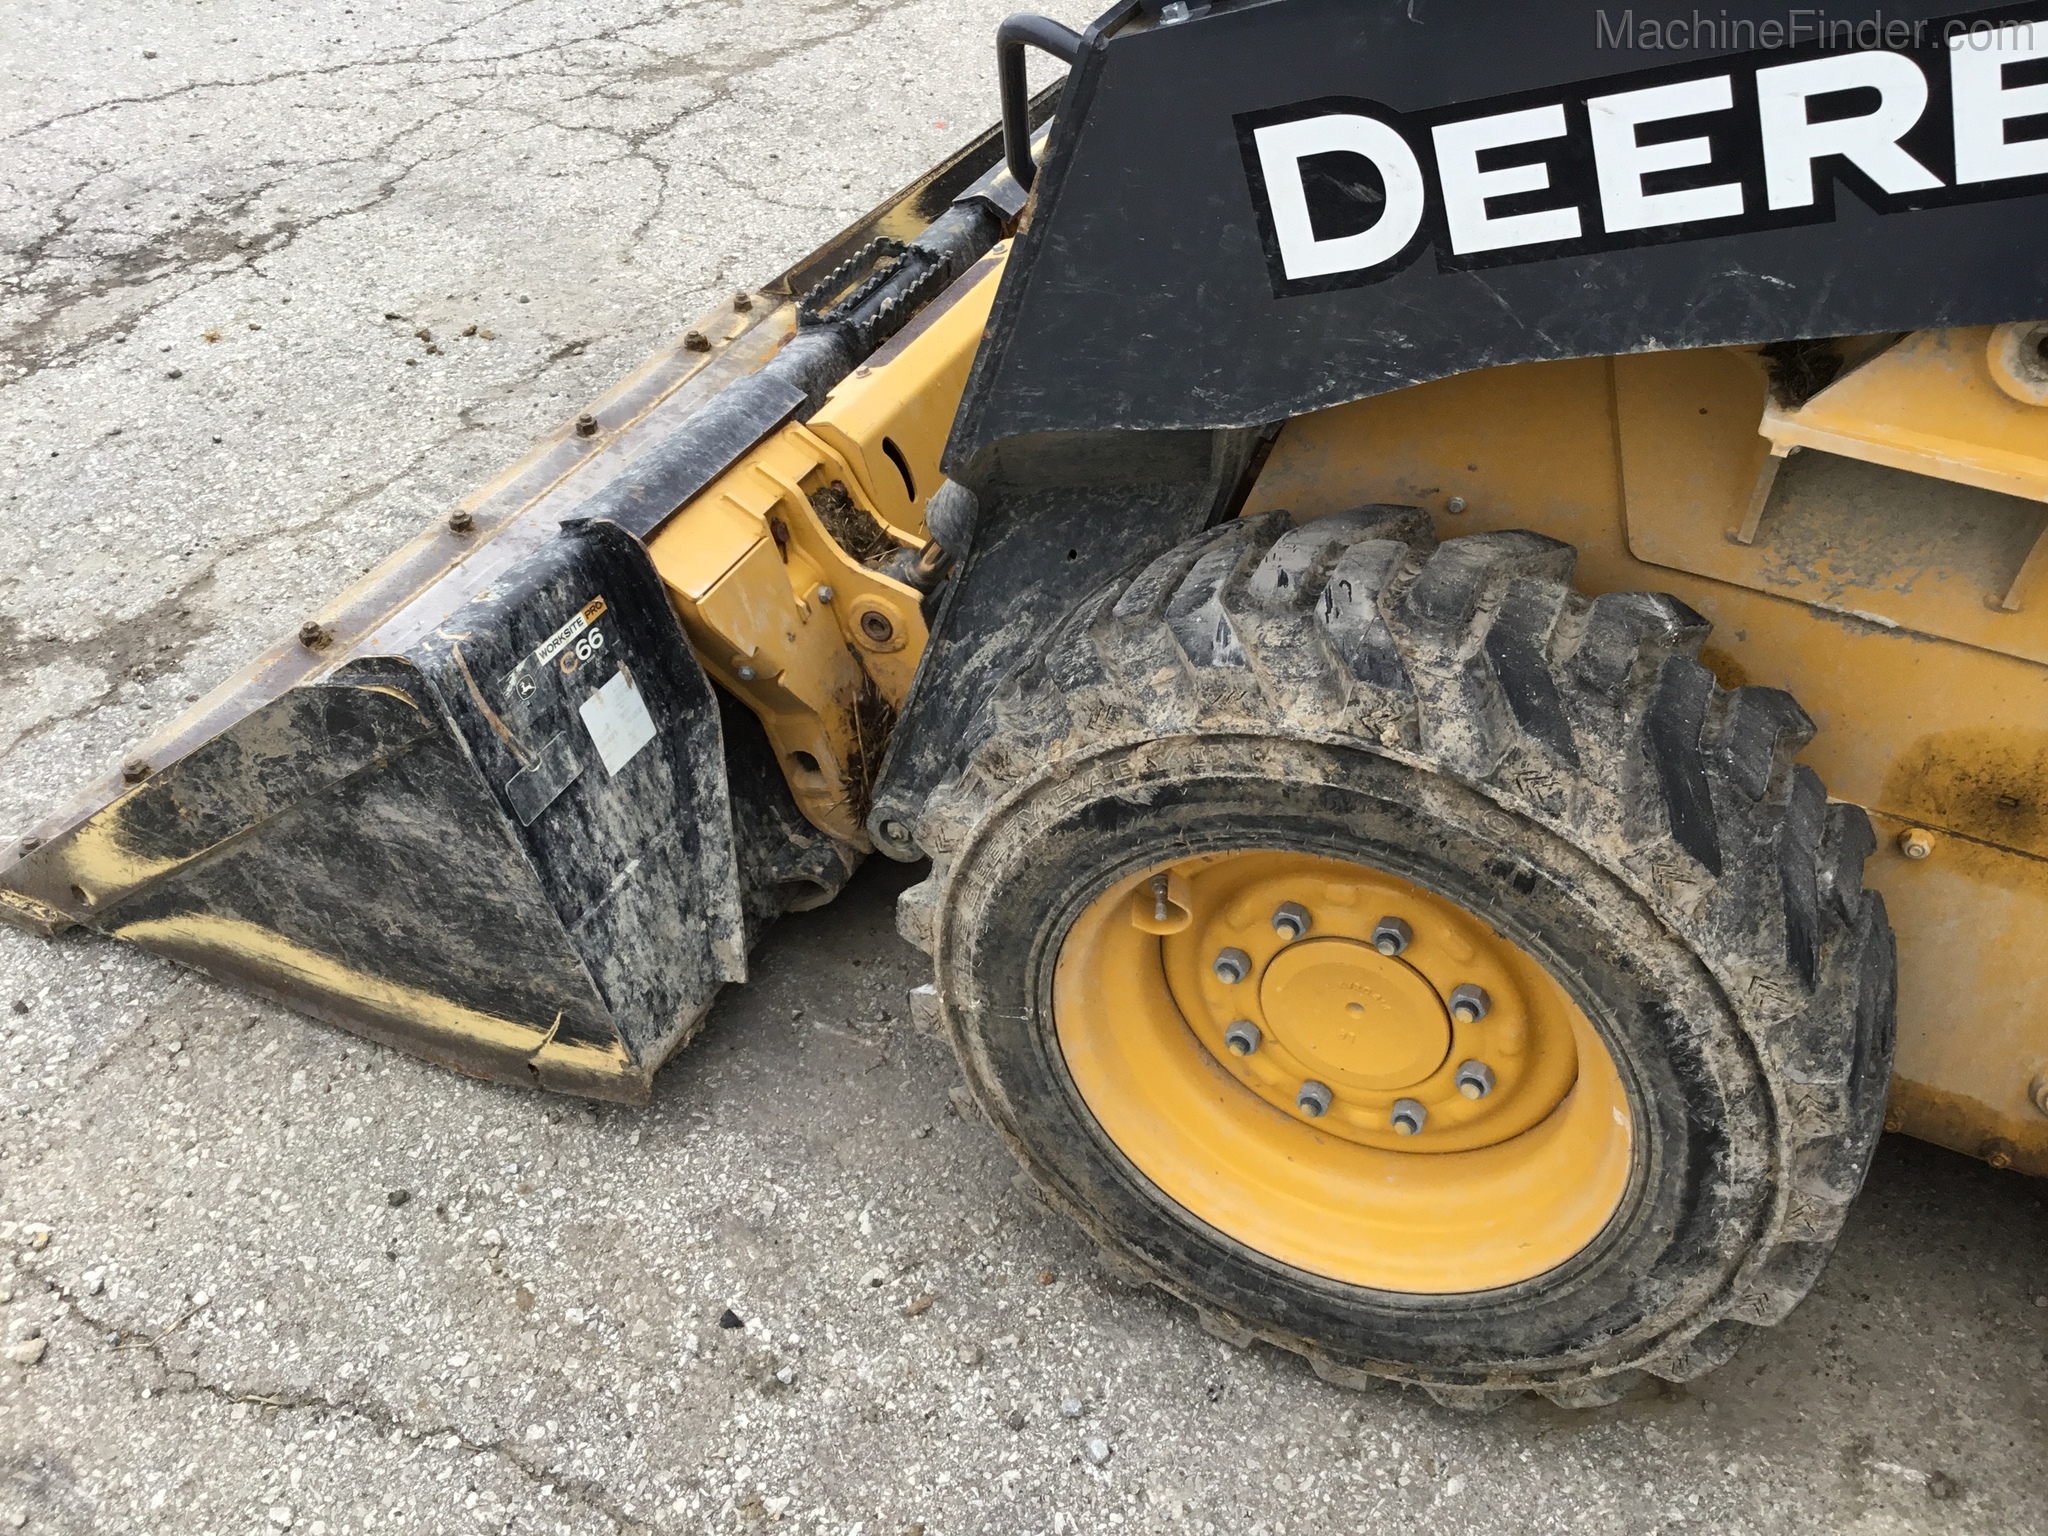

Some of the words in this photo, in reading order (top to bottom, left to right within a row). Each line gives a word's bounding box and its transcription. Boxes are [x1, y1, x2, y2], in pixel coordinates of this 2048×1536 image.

[1253, 20, 2048, 280] DEERE
[538, 616, 584, 660] WORKSITE
[584, 601, 603, 620] PRO
[560, 627, 604, 674] C66
